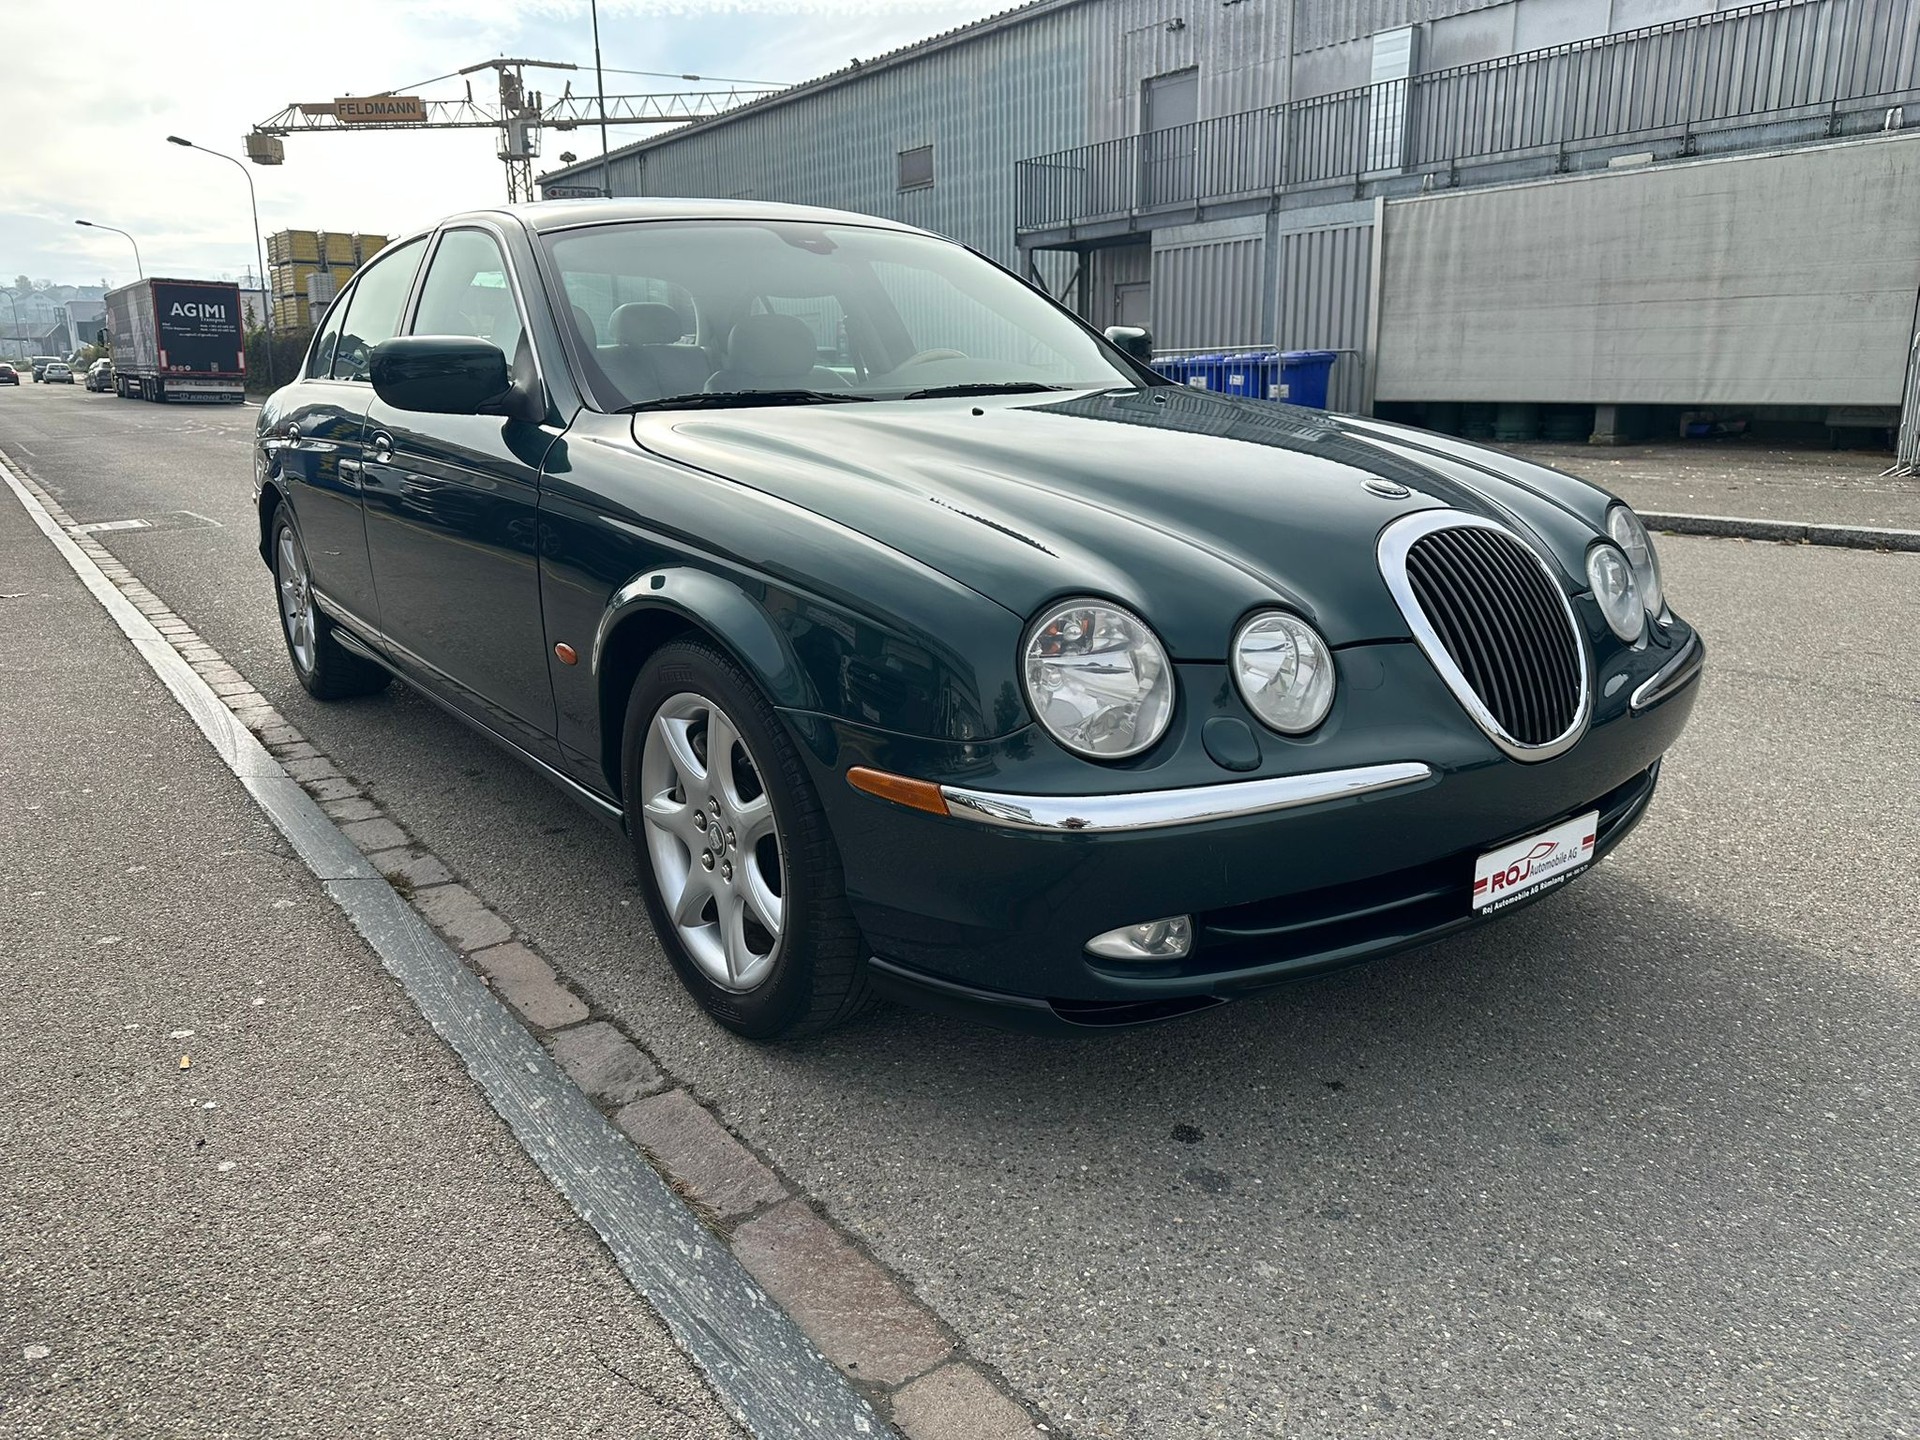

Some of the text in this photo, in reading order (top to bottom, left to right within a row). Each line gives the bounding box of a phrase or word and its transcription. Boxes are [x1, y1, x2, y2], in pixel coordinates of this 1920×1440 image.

[338, 102, 416, 115] FELDMANN
[170, 302, 226, 319] AGIMI
[1491, 860, 1531, 893] ROJ
[1529, 852, 1567, 877] Automobile
[1567, 847, 1578, 860] AG
[1482, 904, 1493, 915] Roj
[1494, 890, 1530, 910] Automobile
[1530, 885, 1539, 896] AG
